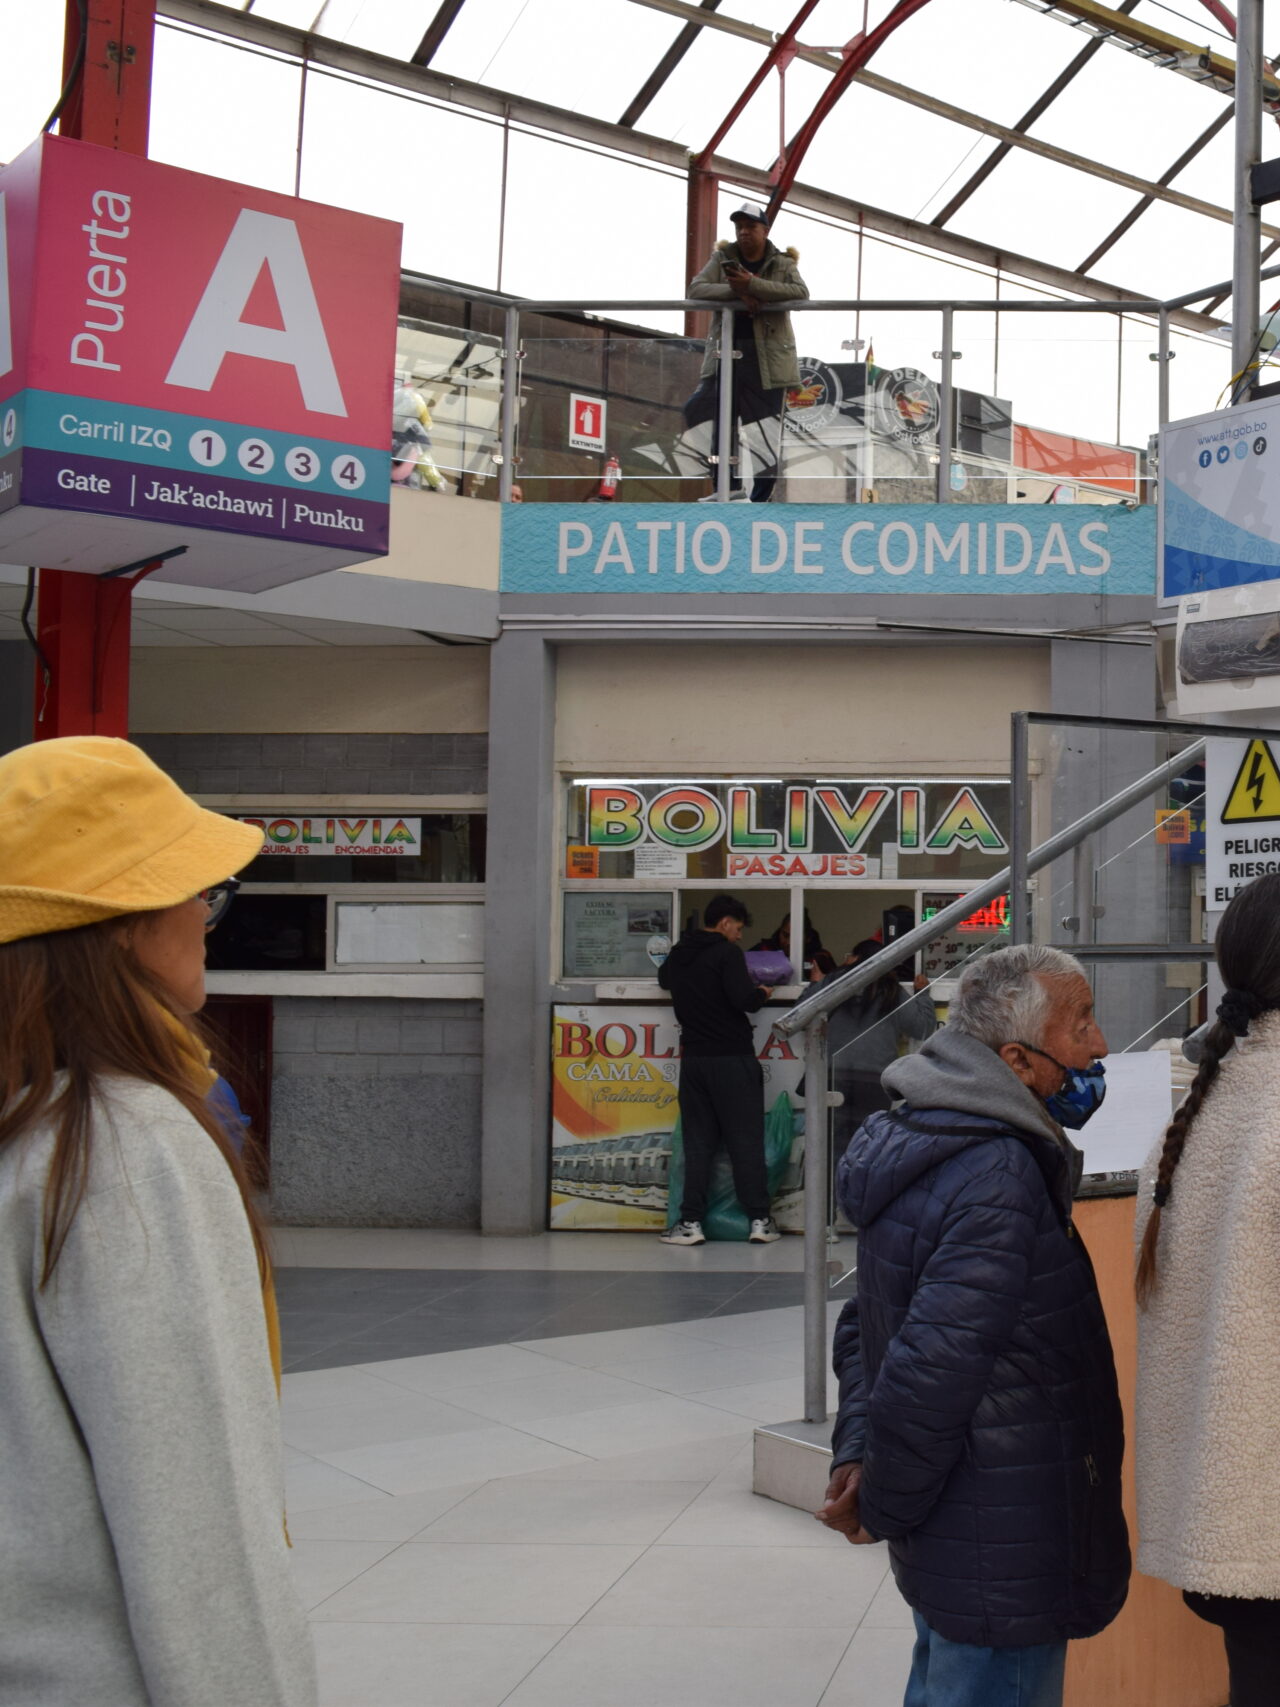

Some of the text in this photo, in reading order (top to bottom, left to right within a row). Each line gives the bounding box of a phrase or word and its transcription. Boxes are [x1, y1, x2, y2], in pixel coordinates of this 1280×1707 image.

[70, 189, 131, 371] Puerta
[164, 207, 348, 417] A
[59, 414, 124, 442] Carril
[130, 424, 173, 451] IZQ
[1197, 421, 1268, 446] www.att.gob.bo
[57, 469, 111, 494] Gate
[294, 504, 365, 532] Punku
[558, 521, 1113, 576] PATIO DE COMIDAS
[586, 785, 1010, 854] BOLIVIA
[335, 845, 404, 855] ENCOMIENDAS
[729, 854, 867, 877] PASAJES
[567, 1063, 651, 1081] CAMA
